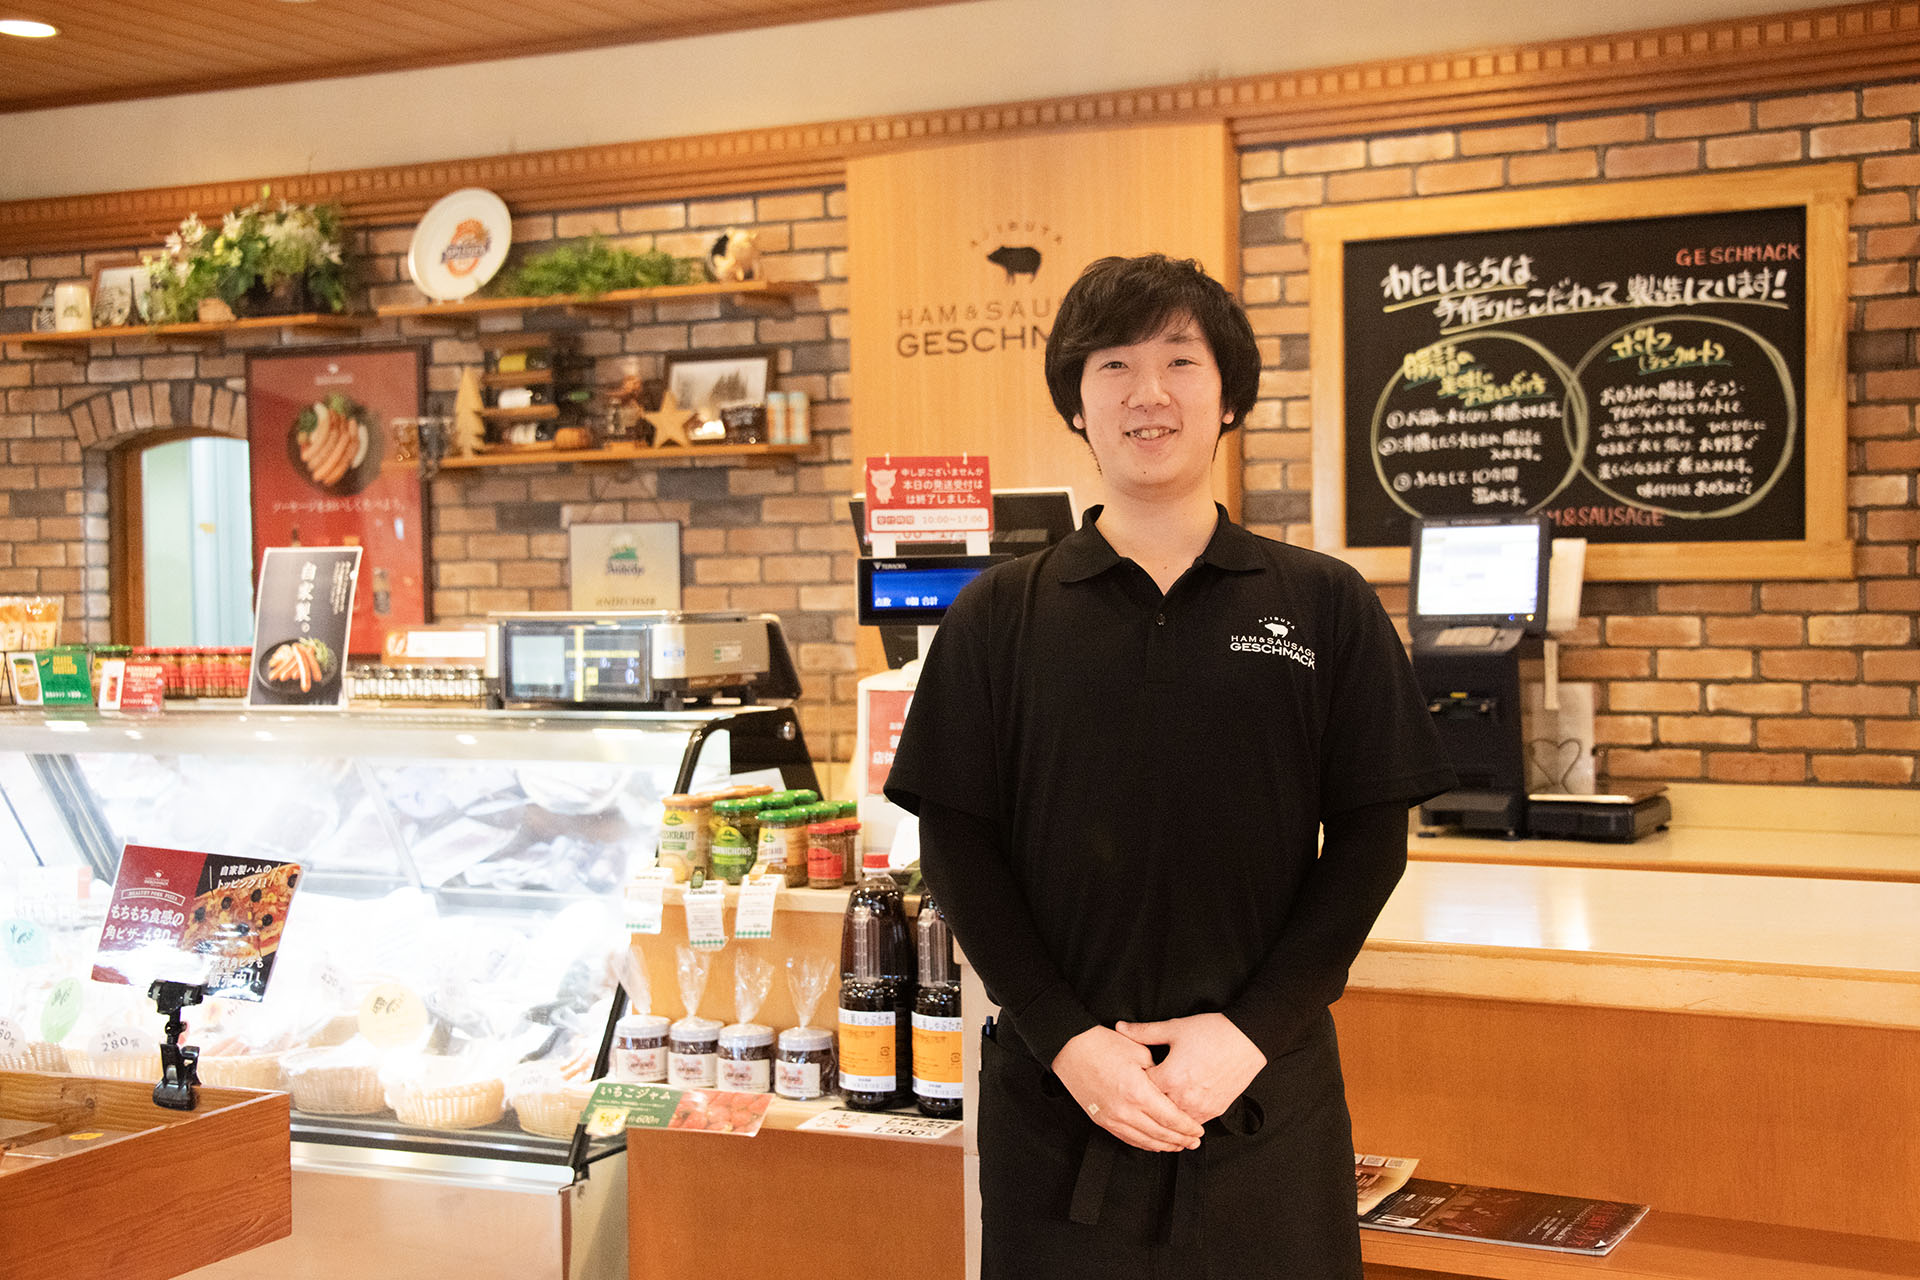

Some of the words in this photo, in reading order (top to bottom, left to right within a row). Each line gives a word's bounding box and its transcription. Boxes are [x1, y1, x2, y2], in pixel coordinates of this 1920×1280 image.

[1675, 242, 1800, 267] GESCHMACK
[1380, 253, 1538, 300] わたしたちは
[898, 299, 1062, 327] HAM&SAU
[1433, 277, 1619, 328] 手作りにこだわって
[901, 467, 984, 477] 申し訳ございませんが
[903, 479, 984, 491] 本日の発送受付は
[905, 493, 982, 505] は終了しました。
[294, 561, 317, 633] 自家製。
[1229, 642, 1316, 671] GESCHMACK
[219, 864, 272, 876] 自家製ハムの
[111, 903, 185, 927] もちもち食感の
